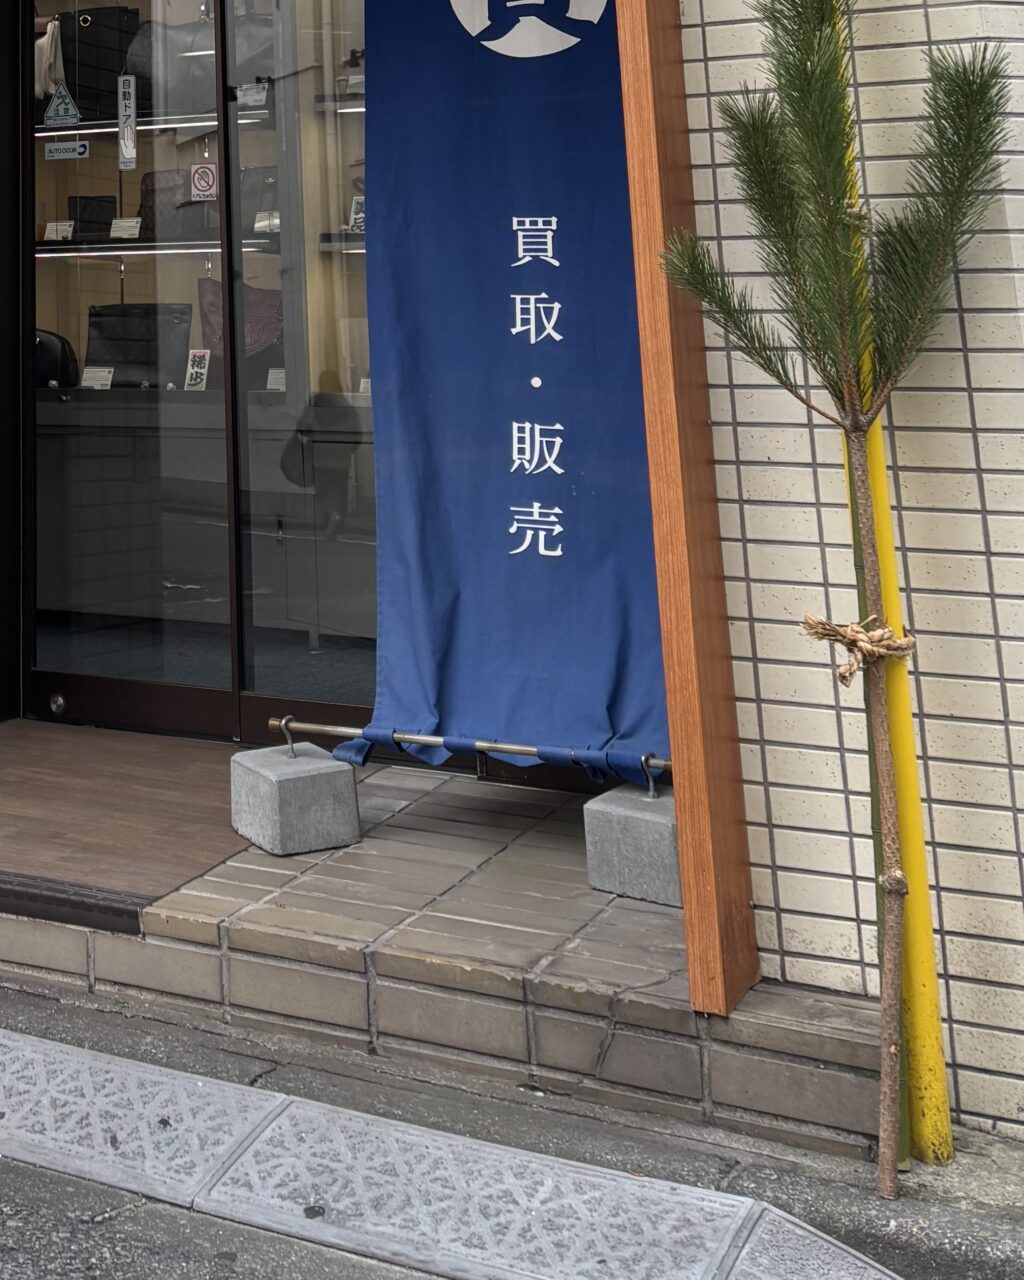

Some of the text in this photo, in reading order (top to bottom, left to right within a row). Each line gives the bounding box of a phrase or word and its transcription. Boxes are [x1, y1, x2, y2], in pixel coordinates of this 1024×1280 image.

[121, 78, 133, 126] 自動ドア
[187, 353, 208, 387] 稀少
[508, 216, 566, 557] 買取・販売
